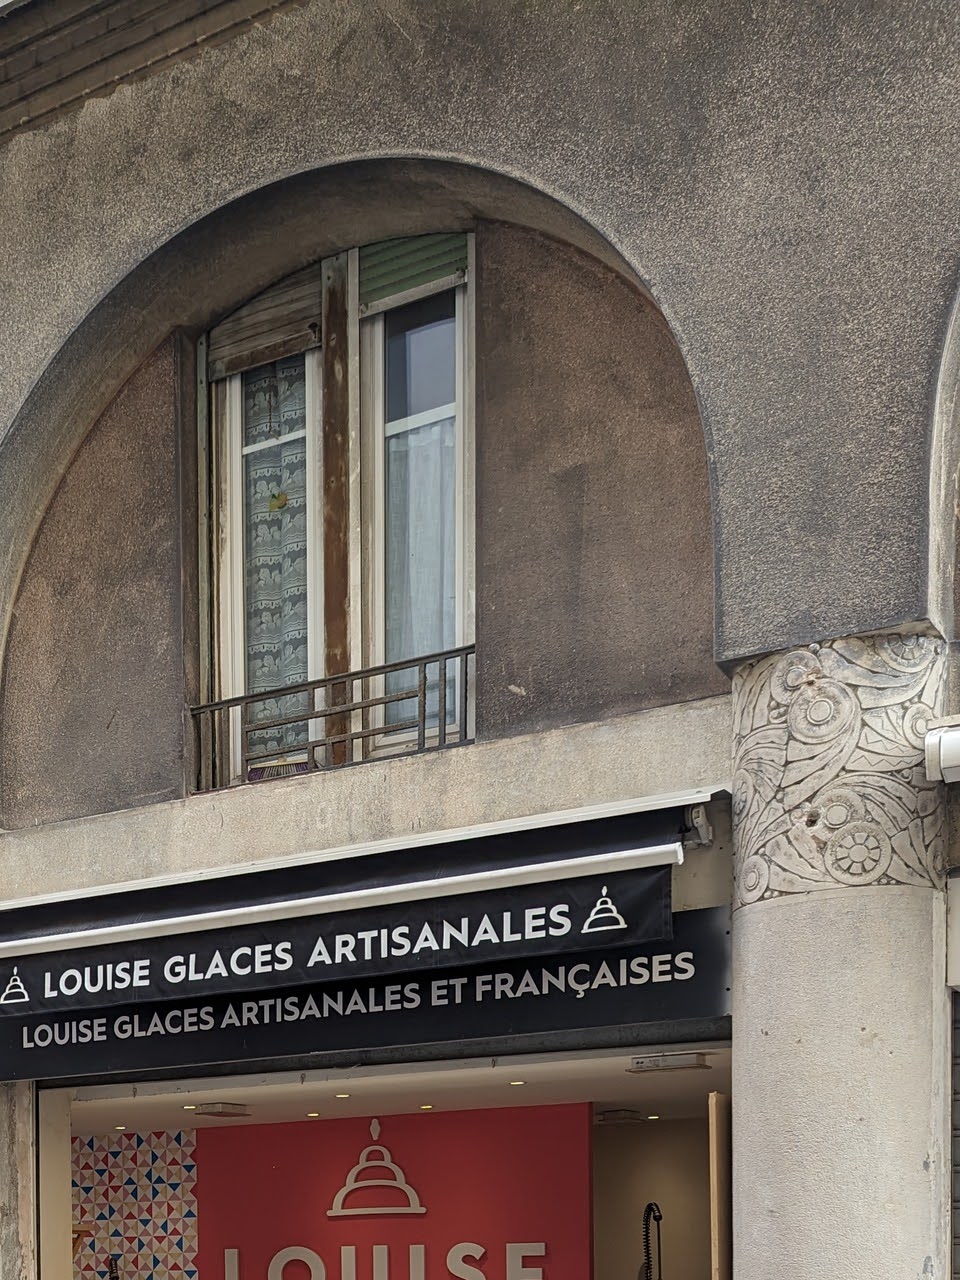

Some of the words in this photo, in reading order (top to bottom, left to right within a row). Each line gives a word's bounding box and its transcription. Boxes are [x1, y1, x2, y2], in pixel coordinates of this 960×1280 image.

[22, 1018, 107, 1048] LOUISE
[113, 1006, 215, 1040] GLACES
[220, 983, 421, 1029] ARTISANALES
[431, 977, 468, 1007] ET
[476, 951, 696, 1002] FRANÇAISES
[43, 958, 150, 999] LOUISE
[163, 941, 293, 984] GLACES
[307, 904, 572, 967] ARTISANALES
